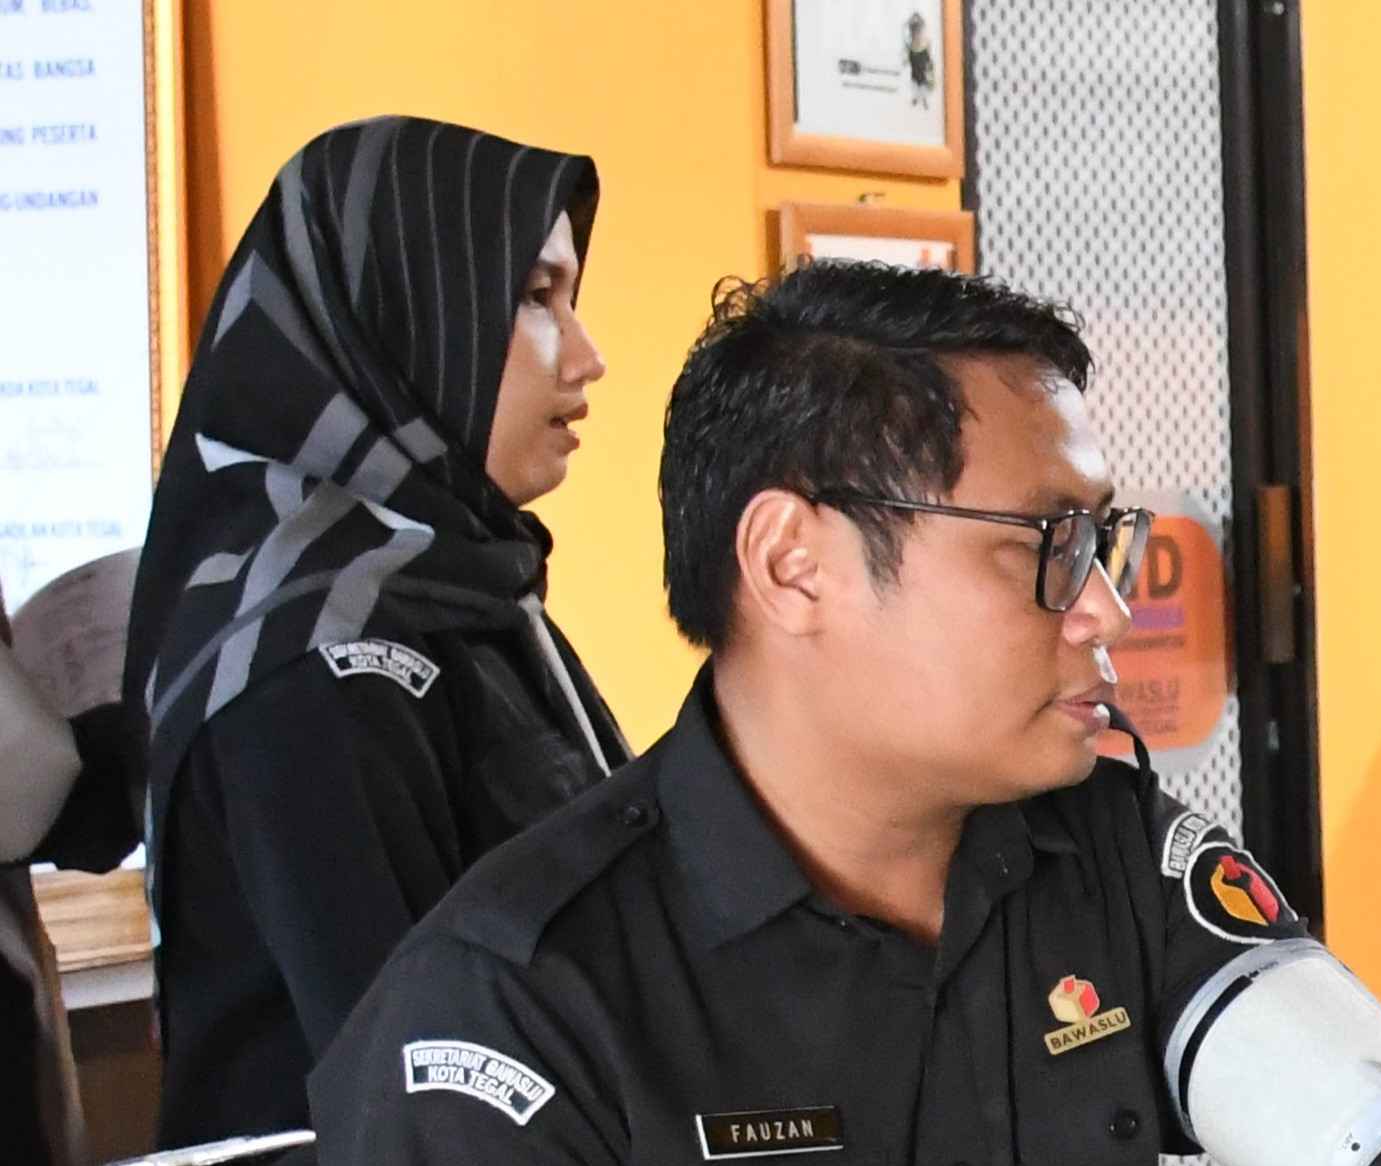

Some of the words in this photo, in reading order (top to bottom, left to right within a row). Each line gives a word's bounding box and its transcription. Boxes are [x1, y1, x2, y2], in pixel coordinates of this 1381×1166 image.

[1050, 1011, 1127, 1050] BAWASLU
[412, 1048, 487, 1071] SEKRETARIAT
[484, 1059, 545, 1101] BAWASLU
[428, 1065, 465, 1084] KOTA
[469, 1070, 515, 1105] TEGAL
[730, 1119, 814, 1143] FAUZAN
